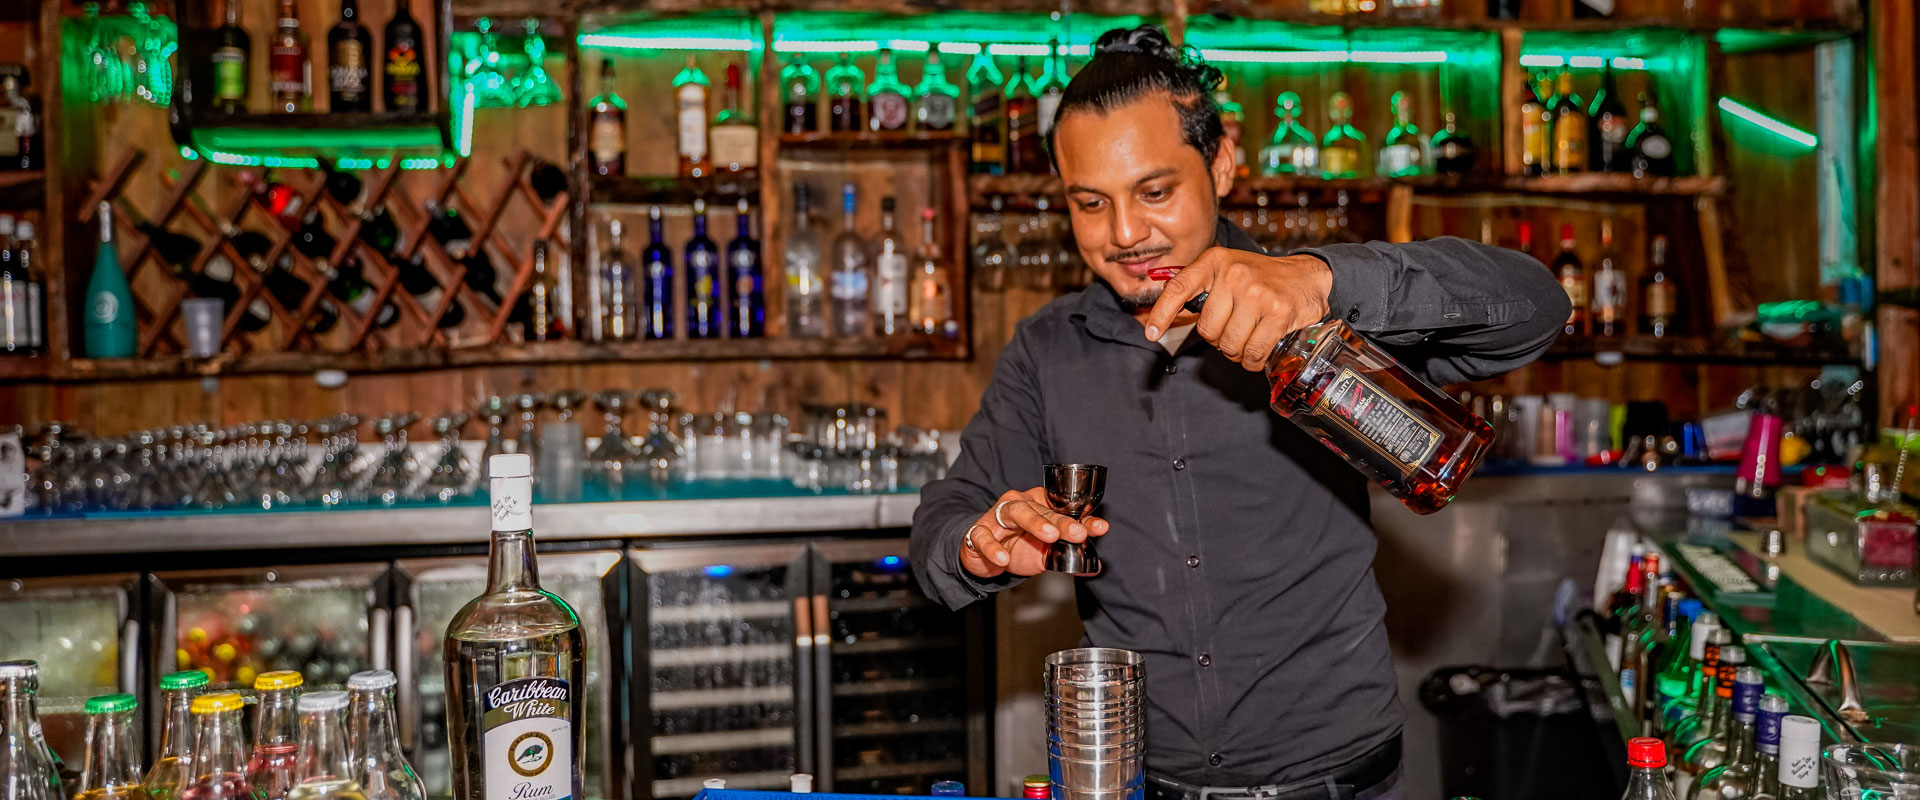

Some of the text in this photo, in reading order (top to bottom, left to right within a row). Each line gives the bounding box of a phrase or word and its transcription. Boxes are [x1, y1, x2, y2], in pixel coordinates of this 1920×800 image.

[1330, 379, 1350, 404] QUALITY
[1336, 383, 1363, 419] Genuine
[1354, 397, 1367, 412] BEAM
[488, 680, 567, 709] Caribbean
[503, 699, 556, 720] White
[508, 781, 554, 800] Rum
